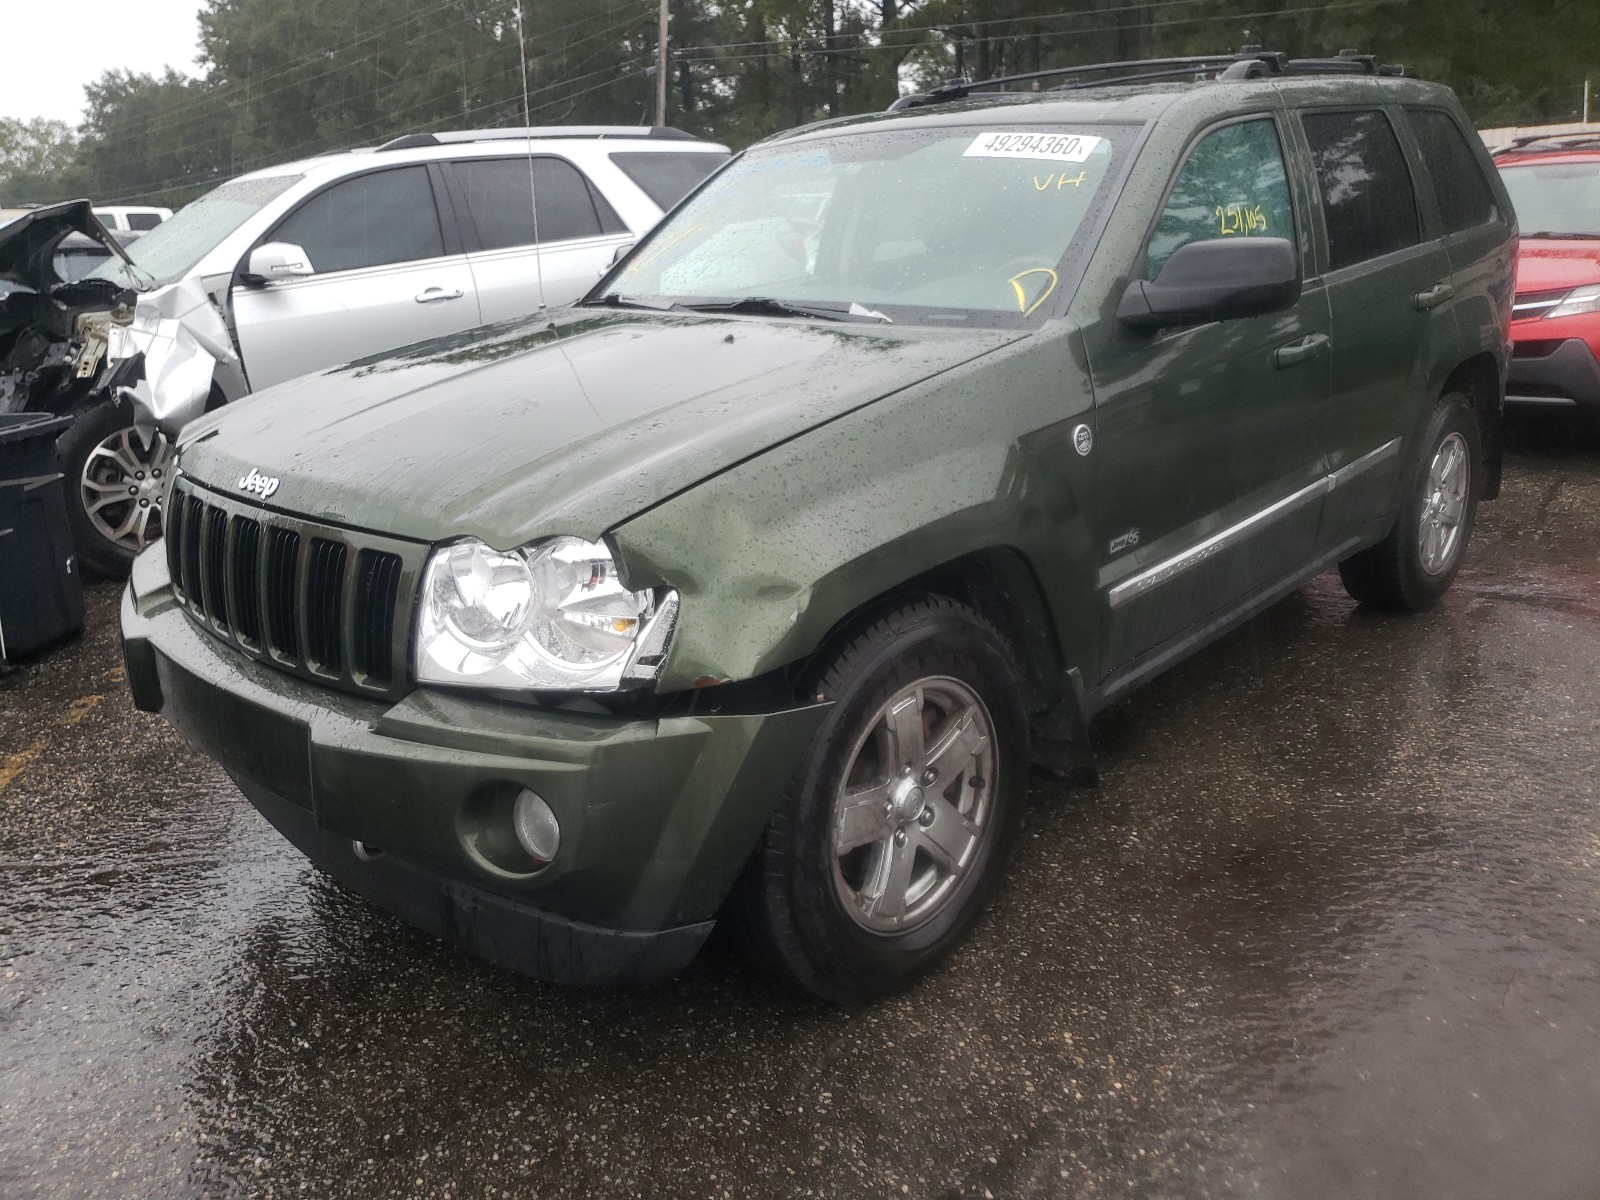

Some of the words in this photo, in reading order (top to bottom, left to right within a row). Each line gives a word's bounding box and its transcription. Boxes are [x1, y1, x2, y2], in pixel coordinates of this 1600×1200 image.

[984, 134, 1081, 155] 49294360
[238, 467, 280, 500] Jeep
[1111, 537, 1126, 551] Jeep
